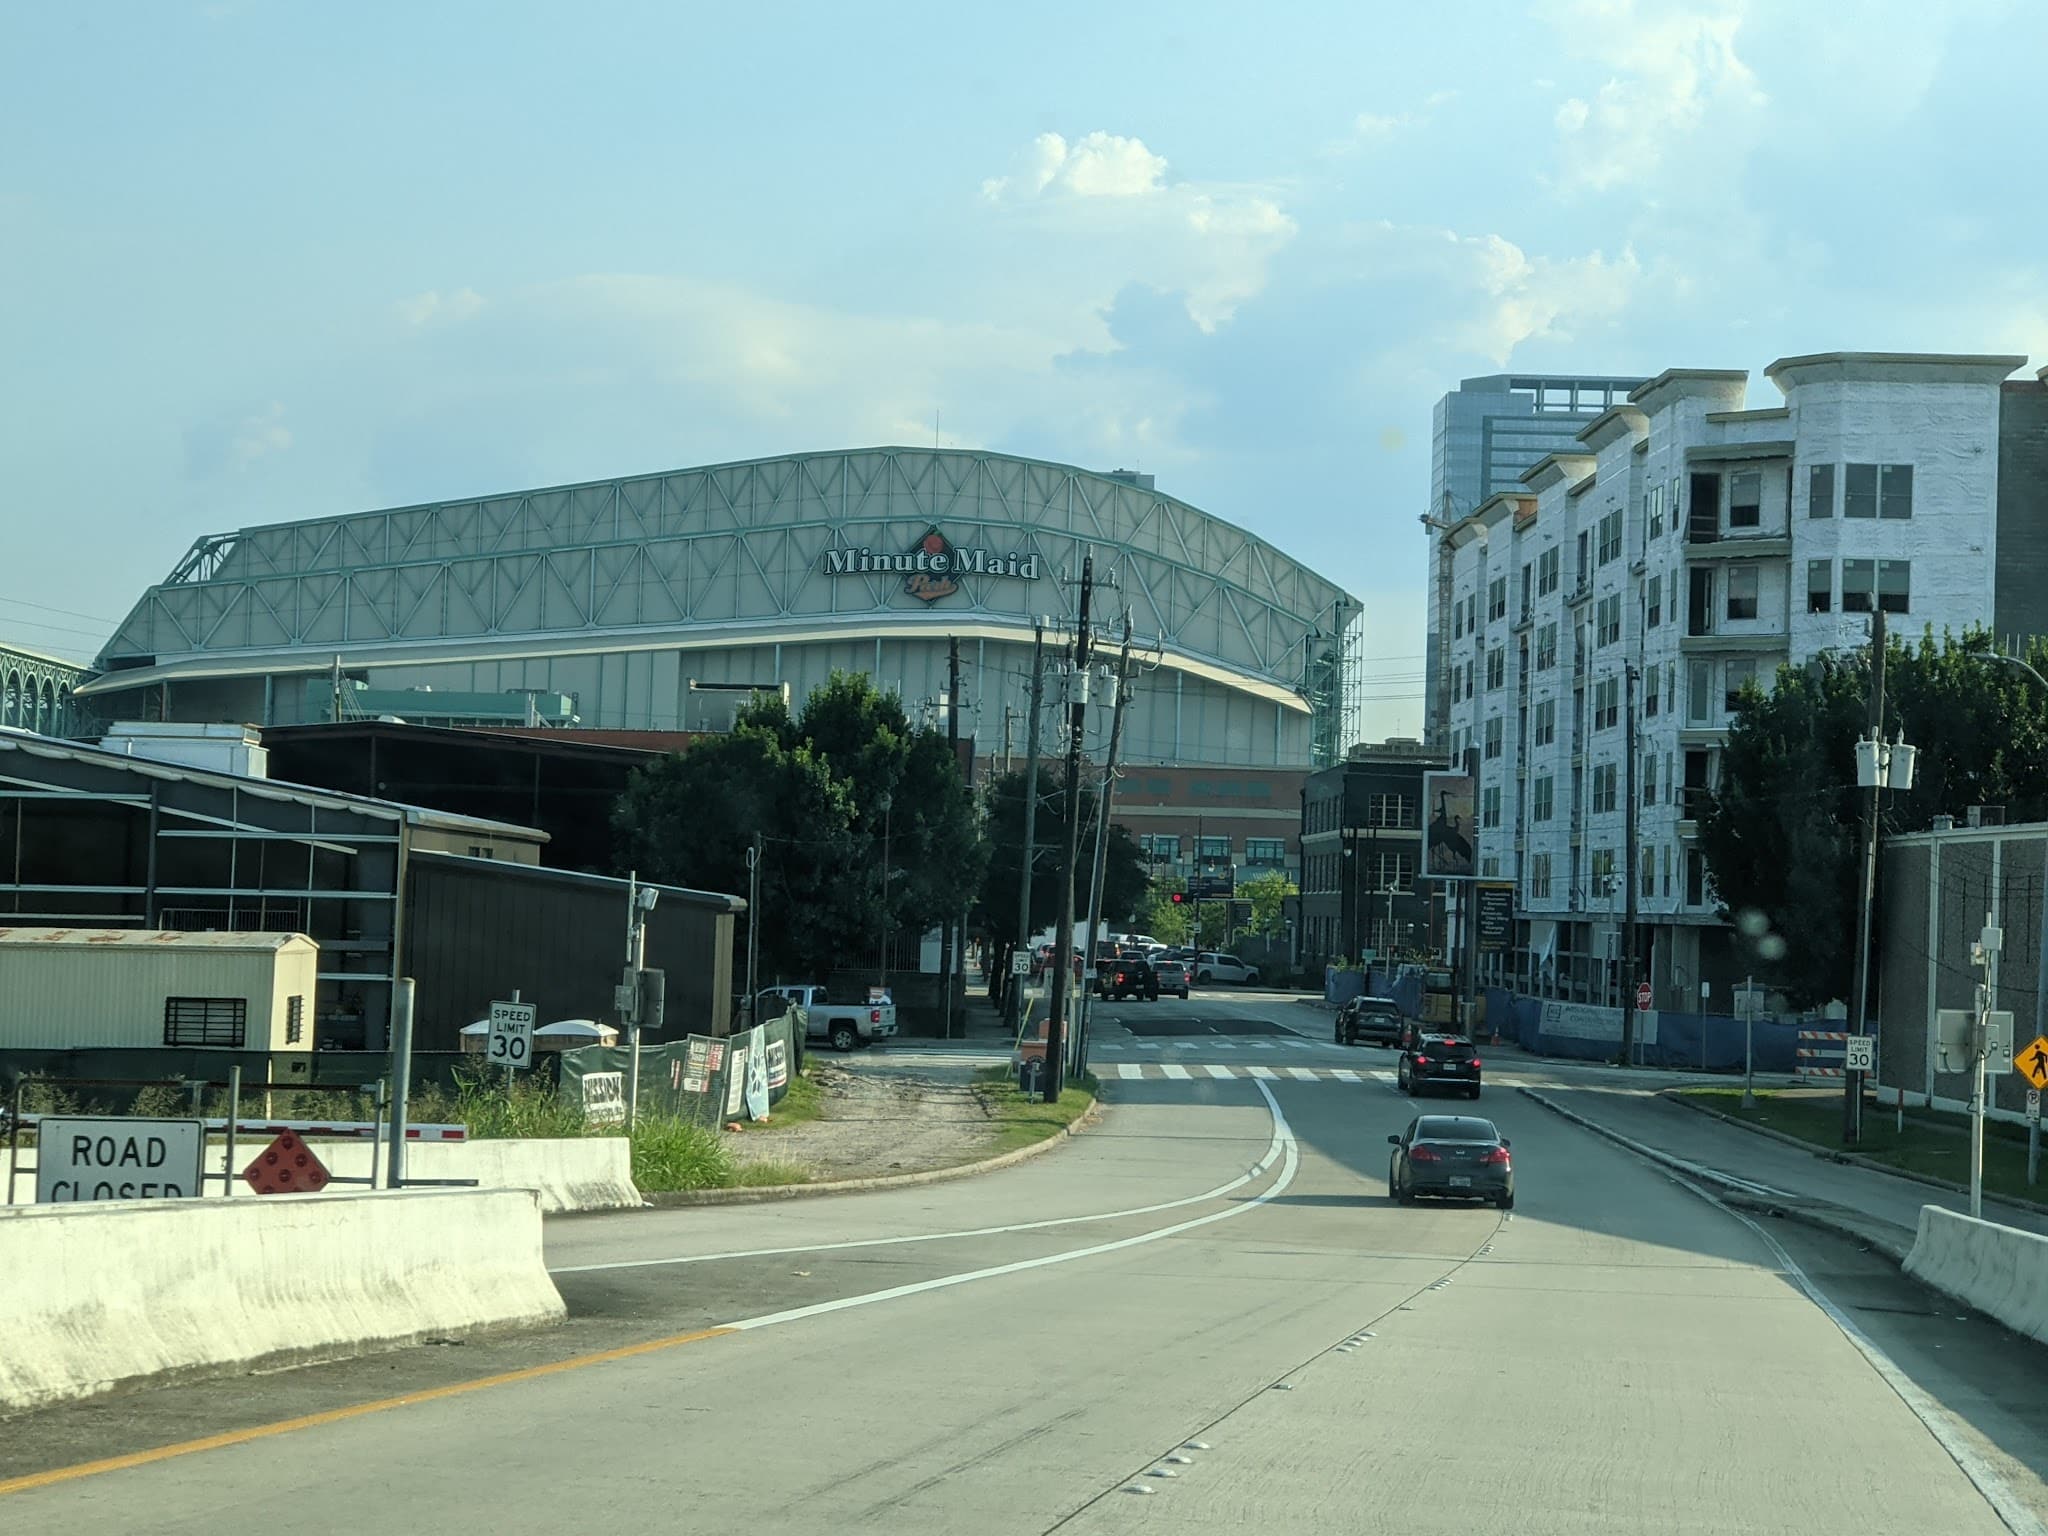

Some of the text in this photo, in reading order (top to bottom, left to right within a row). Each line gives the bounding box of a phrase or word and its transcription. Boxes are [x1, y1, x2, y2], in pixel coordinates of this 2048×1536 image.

[824, 547, 1040, 580] Minute Maid
[1014, 962, 1029, 972] 30
[1638, 991, 1651, 1003] STOP
[494, 1009, 531, 1022] SPEED
[496, 1022, 526, 1034] LIMIT
[491, 1035, 526, 1060] 30
[1849, 1053, 1869, 1066] 30
[71, 1135, 167, 1168] ROAD
